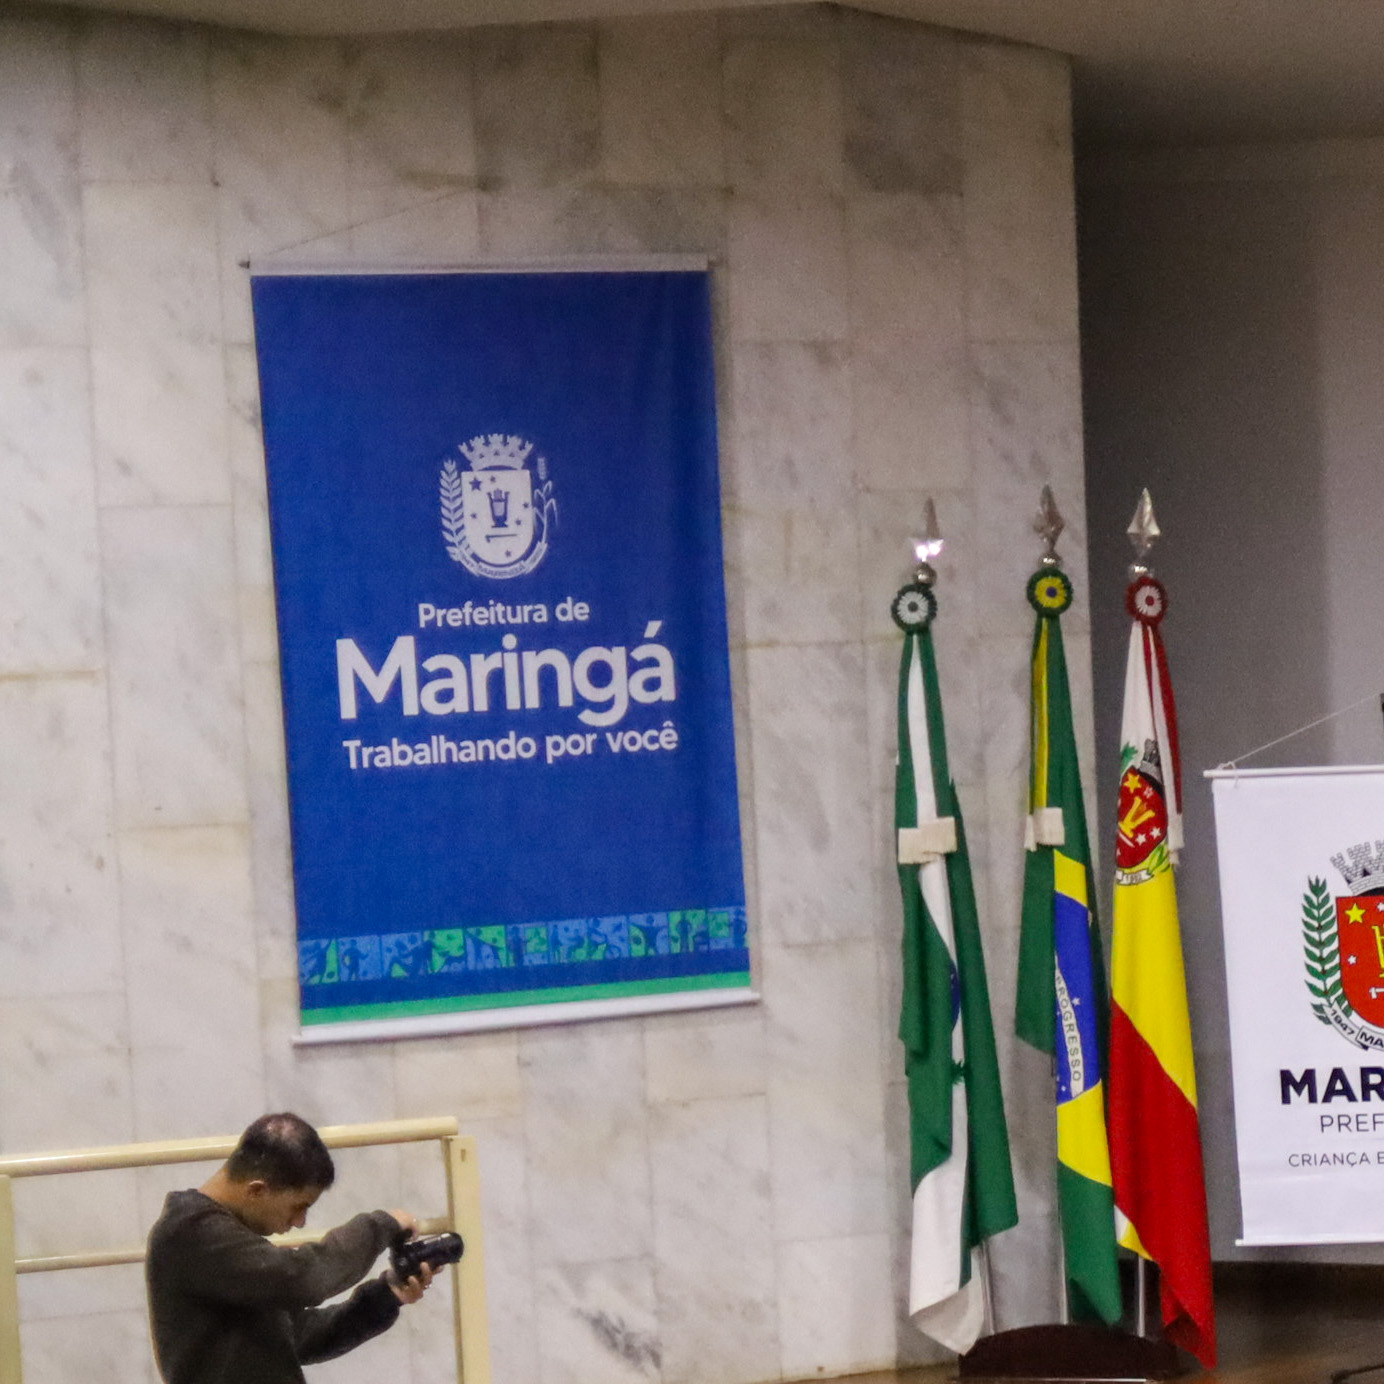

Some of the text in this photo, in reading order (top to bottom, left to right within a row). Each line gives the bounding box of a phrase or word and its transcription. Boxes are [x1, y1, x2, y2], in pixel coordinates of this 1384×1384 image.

[418, 596, 590, 628] Prefeitura de
[336, 620, 676, 727] Maringá
[342, 720, 679, 770] Trabalhando por você
[1330, 1009, 1355, 1035] 1947
[1288, 1151, 1371, 1168] CRIANÇA
